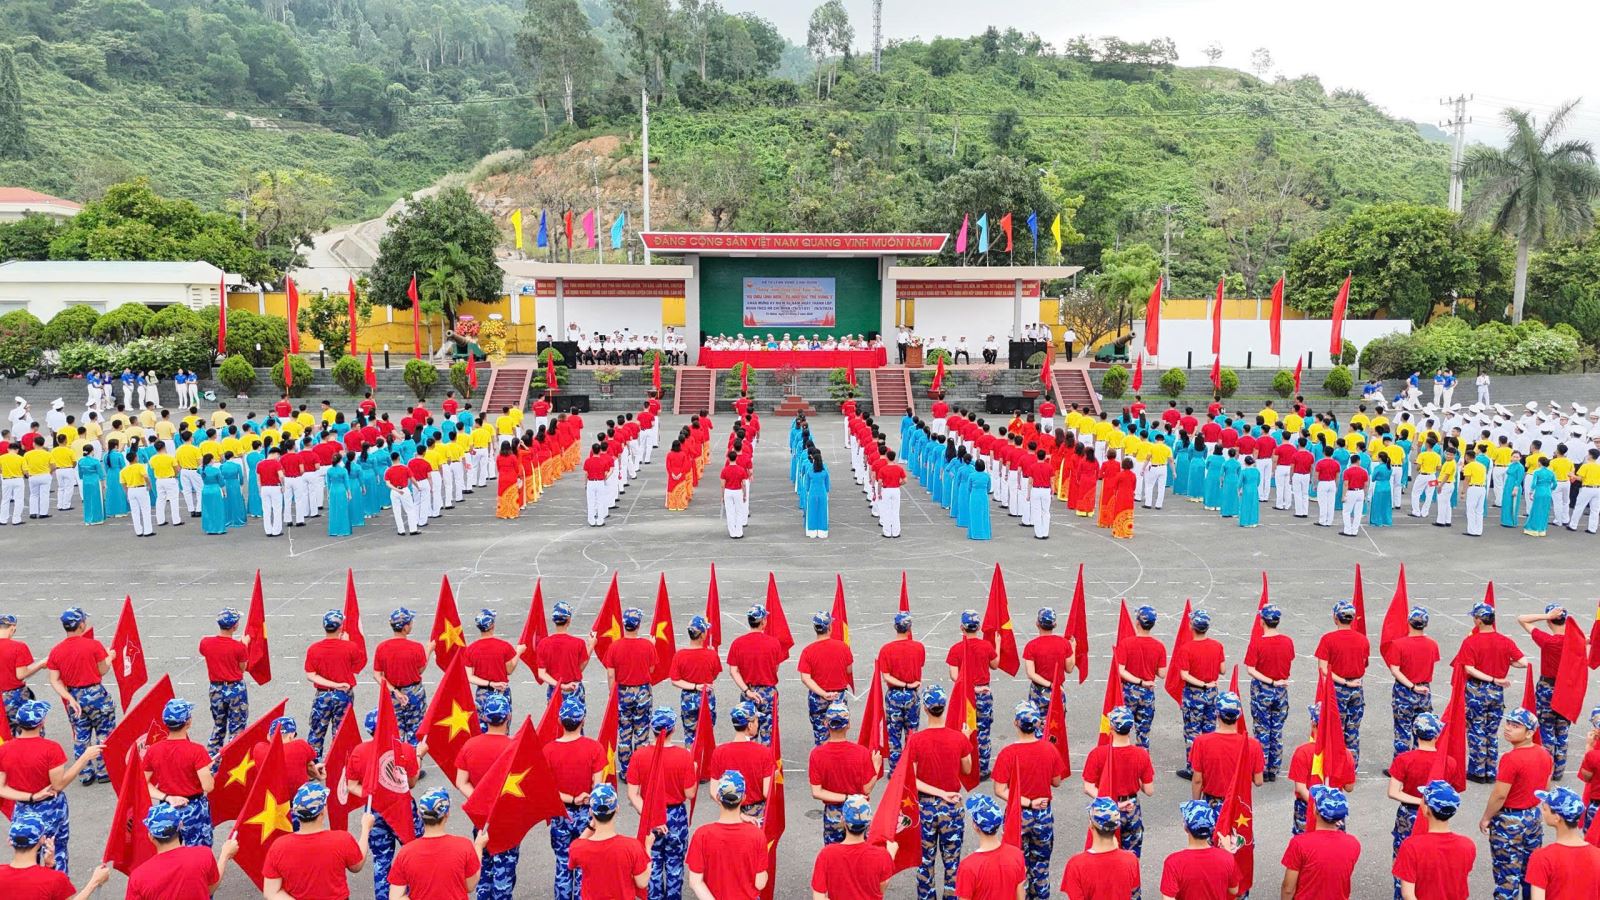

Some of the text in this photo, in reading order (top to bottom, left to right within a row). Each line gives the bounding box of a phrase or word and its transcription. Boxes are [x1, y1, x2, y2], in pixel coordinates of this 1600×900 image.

[653, 235, 933, 248] ĐẢNG CỘNG SẢN VIỆT NAM QUANG VINH MUÔN NĂM
